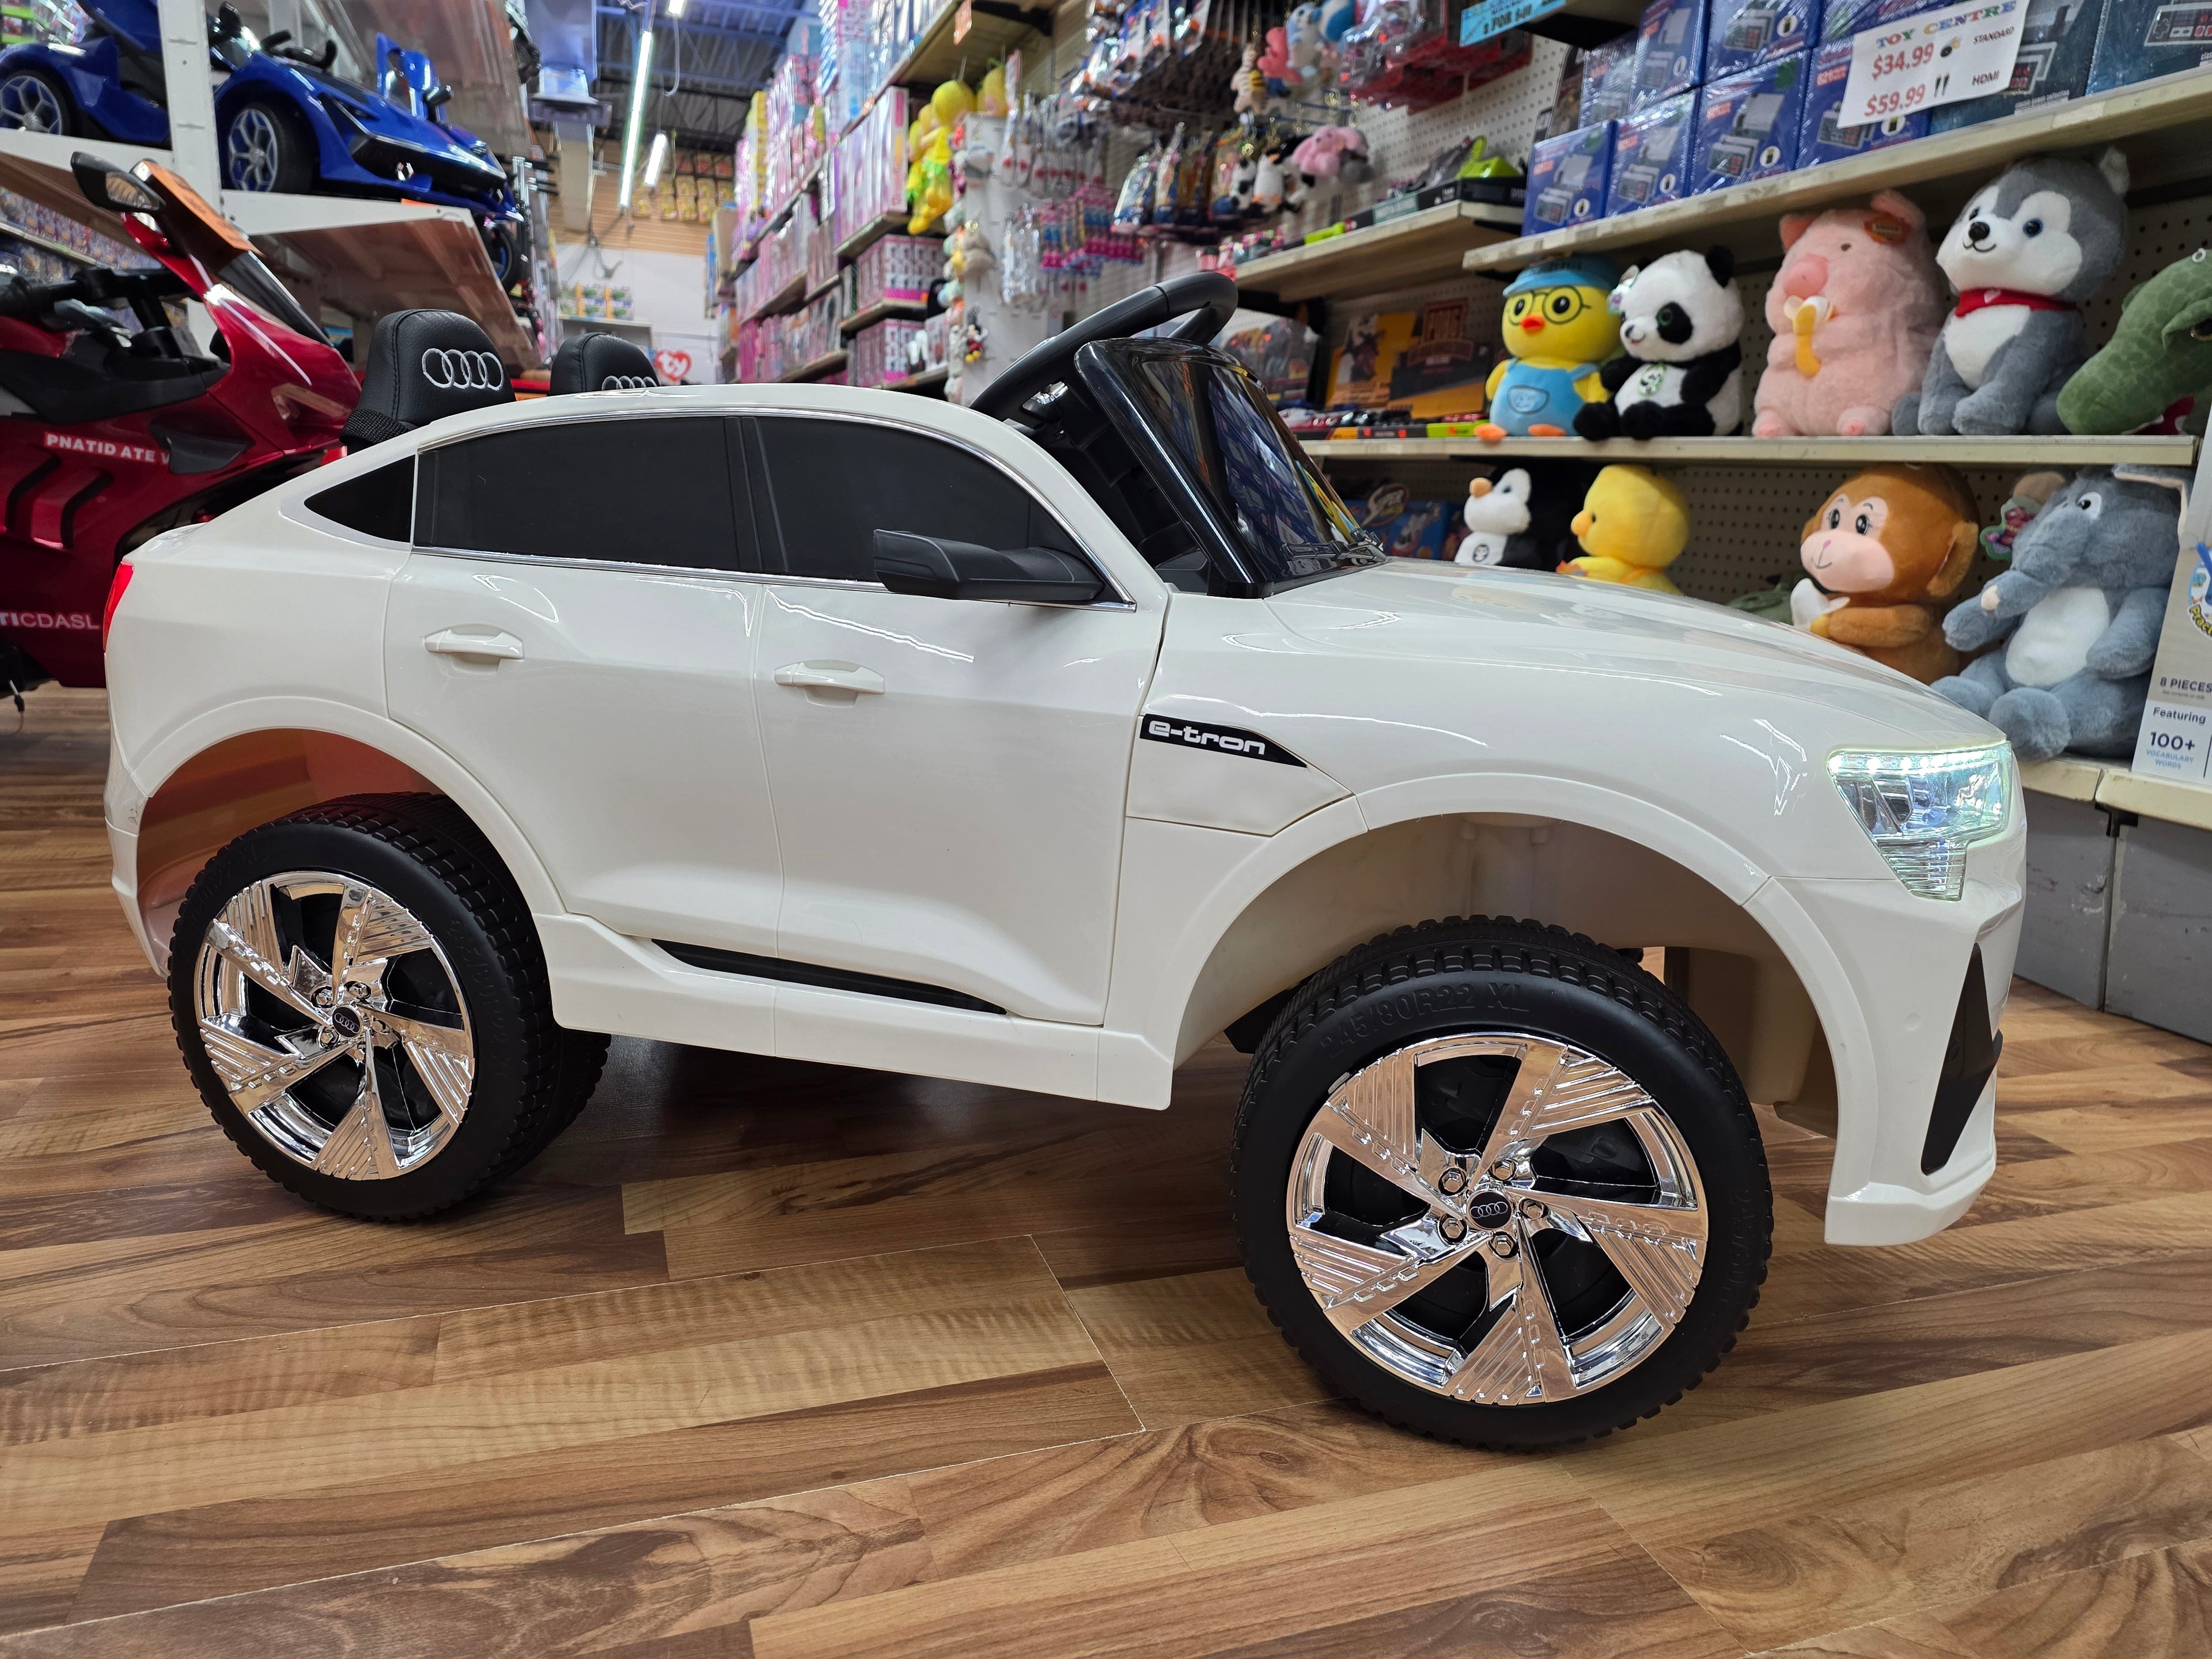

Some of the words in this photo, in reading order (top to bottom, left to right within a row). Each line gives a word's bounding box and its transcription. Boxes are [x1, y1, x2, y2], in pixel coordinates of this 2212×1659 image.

[1876, 28, 1916, 49] TOY
[1923, 1, 2016, 35] CENTRE
[1872, 42, 1934, 80] $34.99
[1972, 26, 2015, 45] STANDARD
[1864, 83, 1926, 117] $59.99
[1972, 69, 2001, 86] HDMI
[46, 433, 116, 456] PNATID
[120, 445, 156, 463] ATE
[2160, 676, 2167, 687] 8
[2170, 678, 2212, 693] PIECES
[2153, 707, 2206, 725] Featuring
[1148, 719, 1266, 756] e-tron
[2150, 731, 2195, 751] 100+
[2146, 749, 2194, 764] VOCABULARY
[2155, 758, 2181, 770] WORDS
